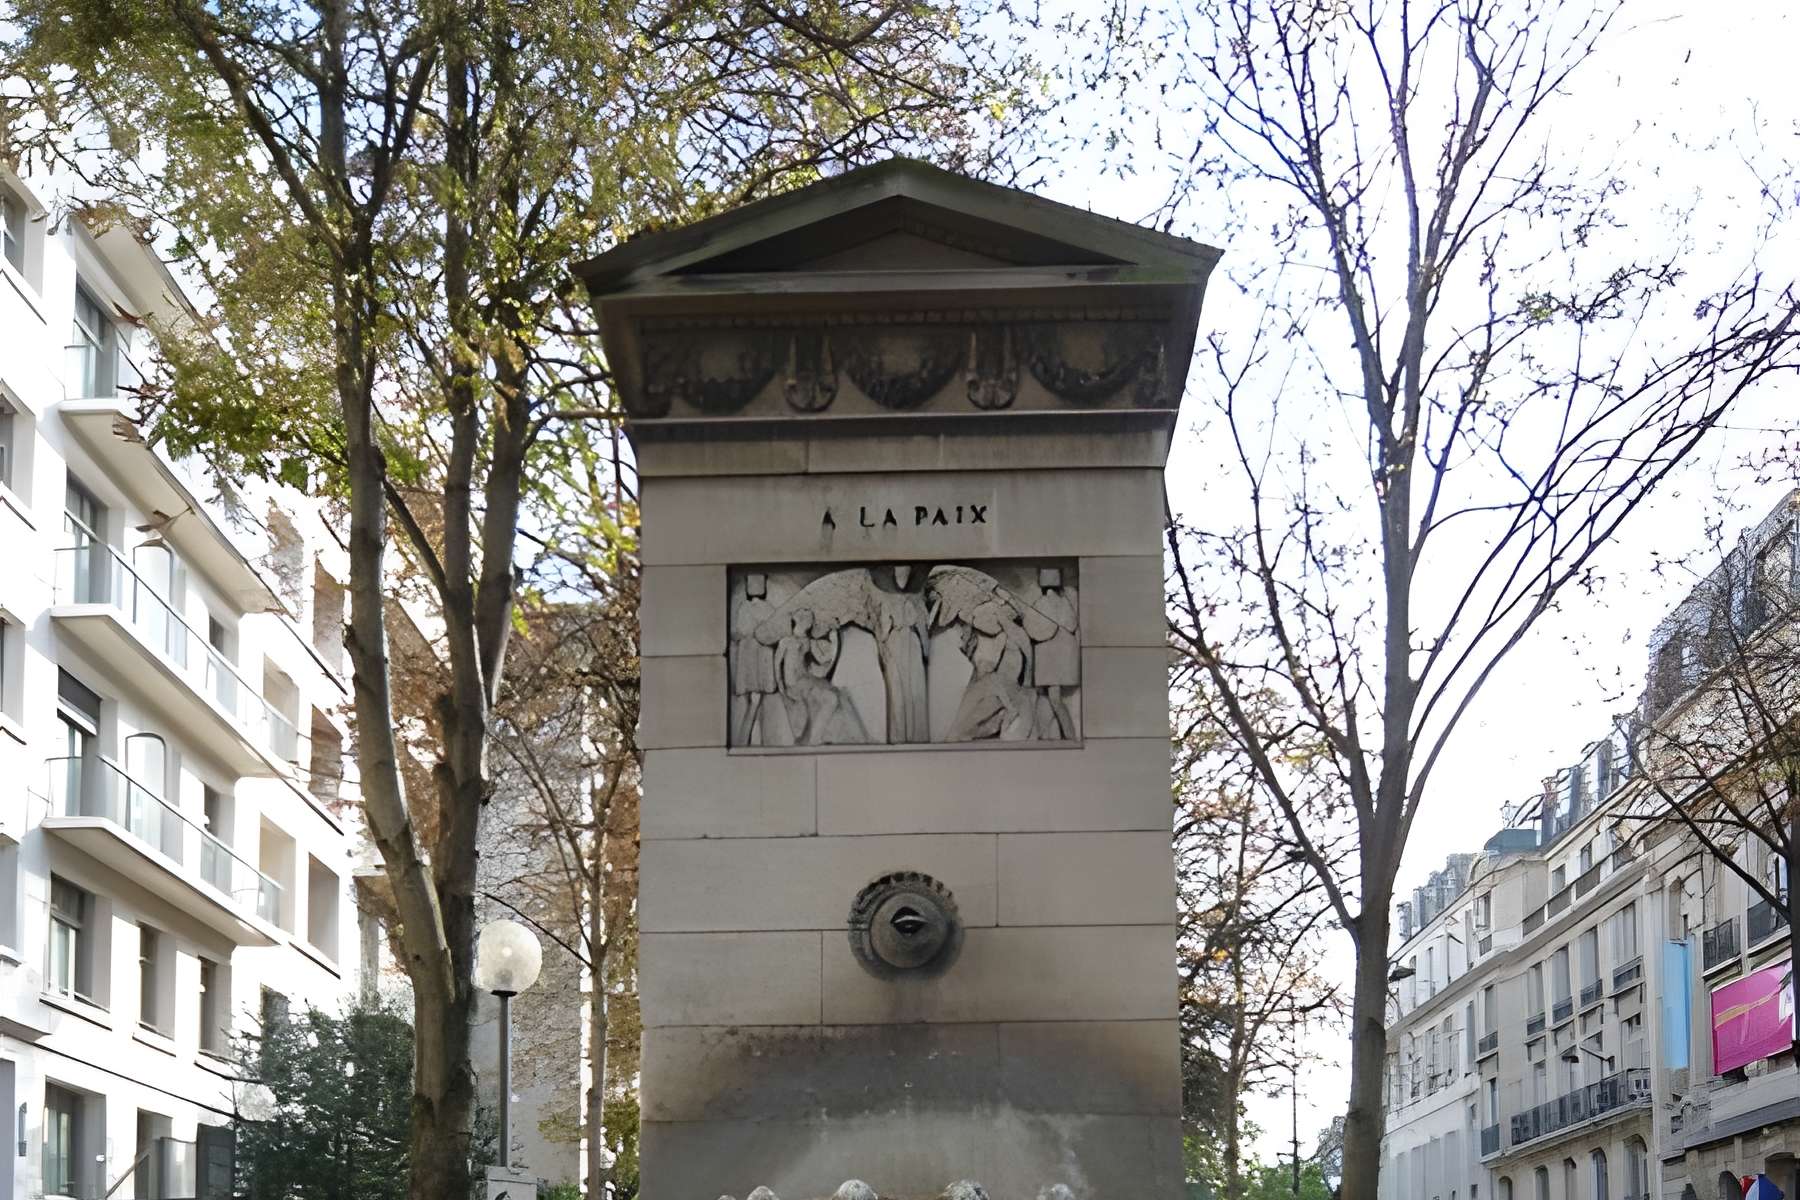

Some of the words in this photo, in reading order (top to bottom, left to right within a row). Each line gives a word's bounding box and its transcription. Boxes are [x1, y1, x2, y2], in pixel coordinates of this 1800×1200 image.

[822, 509, 836, 530] A
[860, 506, 897, 528] LA
[914, 504, 987, 526] PAIX
